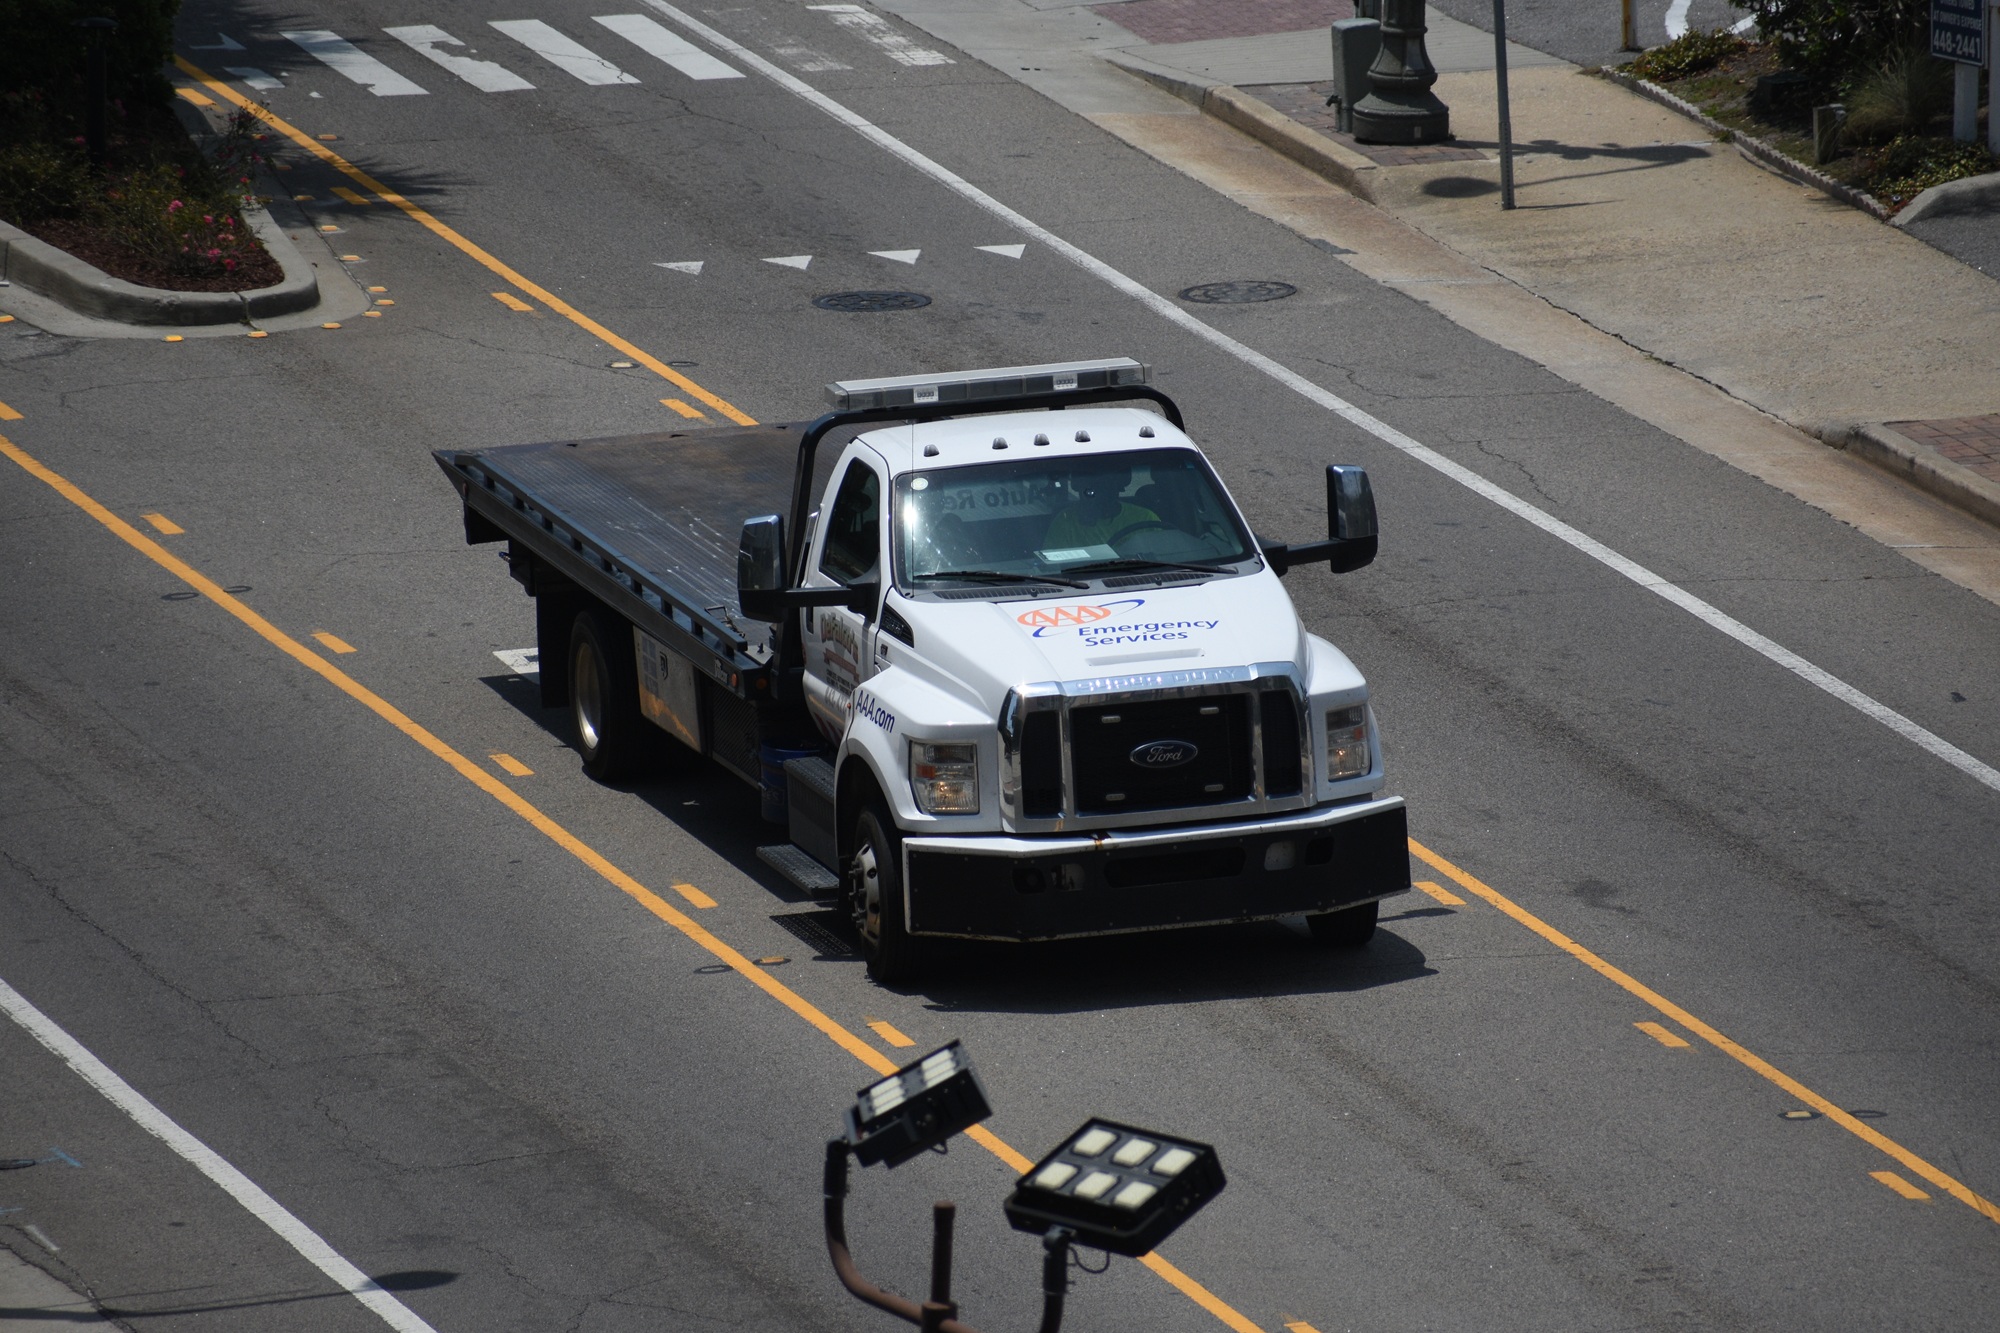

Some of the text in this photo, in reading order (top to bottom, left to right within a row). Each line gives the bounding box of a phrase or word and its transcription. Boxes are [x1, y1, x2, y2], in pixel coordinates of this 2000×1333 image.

[1940, 11, 1960, 26] OWNER'S
[1961, 15, 1982, 31] EXPENSE
[1933, 29, 1981, 59] 448-2441
[1031, 606, 1103, 626] AAA
[1079, 619, 1219, 636] Emergency
[1085, 631, 1188, 647] Services
[1173, 669, 1237, 683] DUTY
[855, 689, 895, 733] AAA.com
[1147, 745, 1183, 762] Ford
